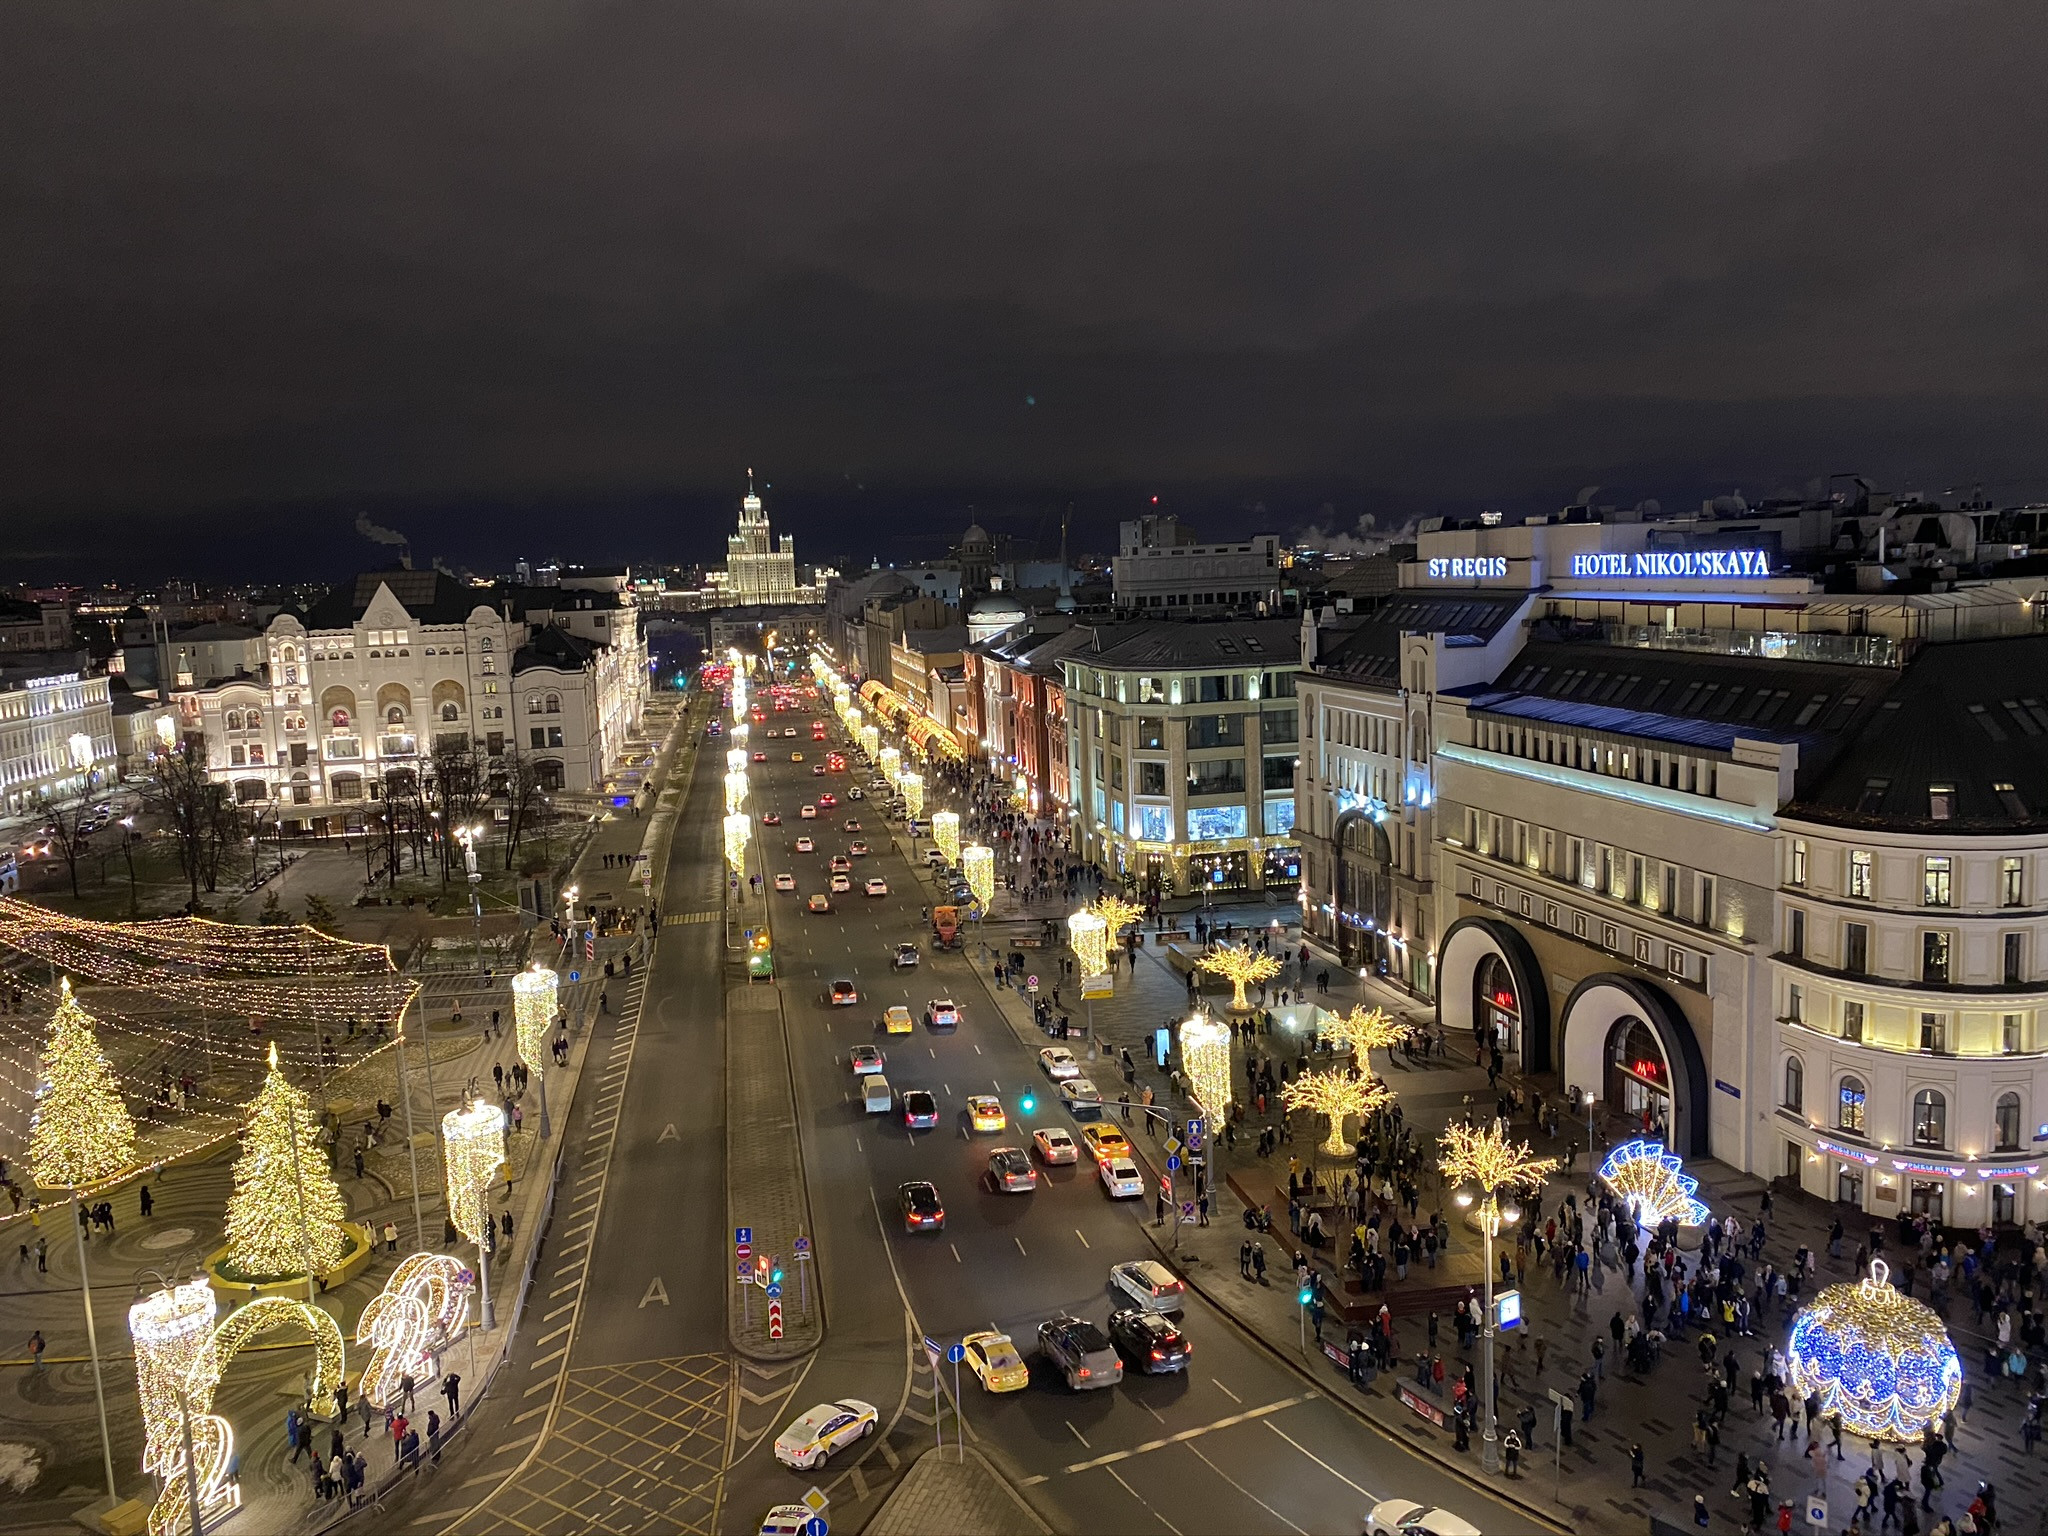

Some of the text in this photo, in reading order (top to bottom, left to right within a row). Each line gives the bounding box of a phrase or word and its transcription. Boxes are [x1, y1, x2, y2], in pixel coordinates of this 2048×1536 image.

[1452, 557, 1507, 576] REGIS
[1574, 550, 1770, 575] HOTEL NIKOL'SKAYA
